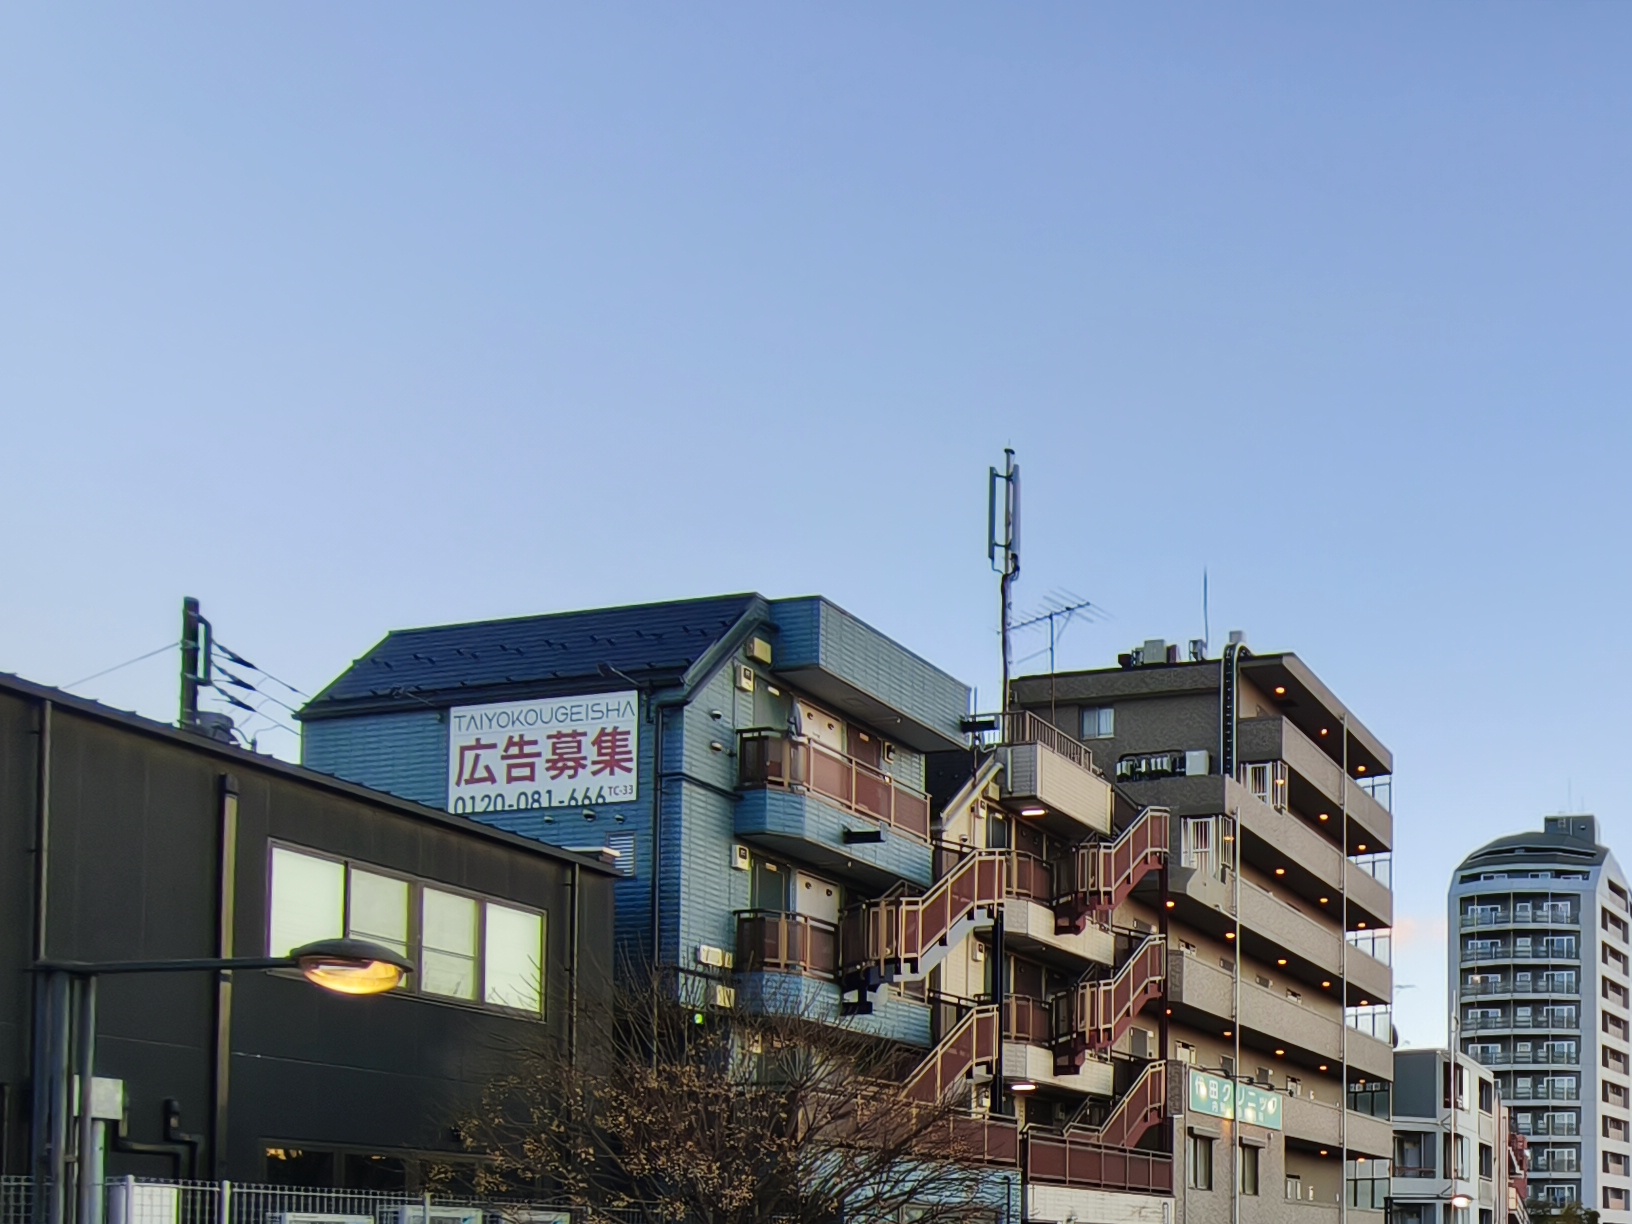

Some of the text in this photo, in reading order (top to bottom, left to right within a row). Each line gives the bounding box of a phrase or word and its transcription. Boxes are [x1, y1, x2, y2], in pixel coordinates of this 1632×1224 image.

[454, 701, 635, 732] TAIYOKOUGEISHA
[455, 726, 634, 788] 広告募集
[608, 785, 634, 797] TC-33
